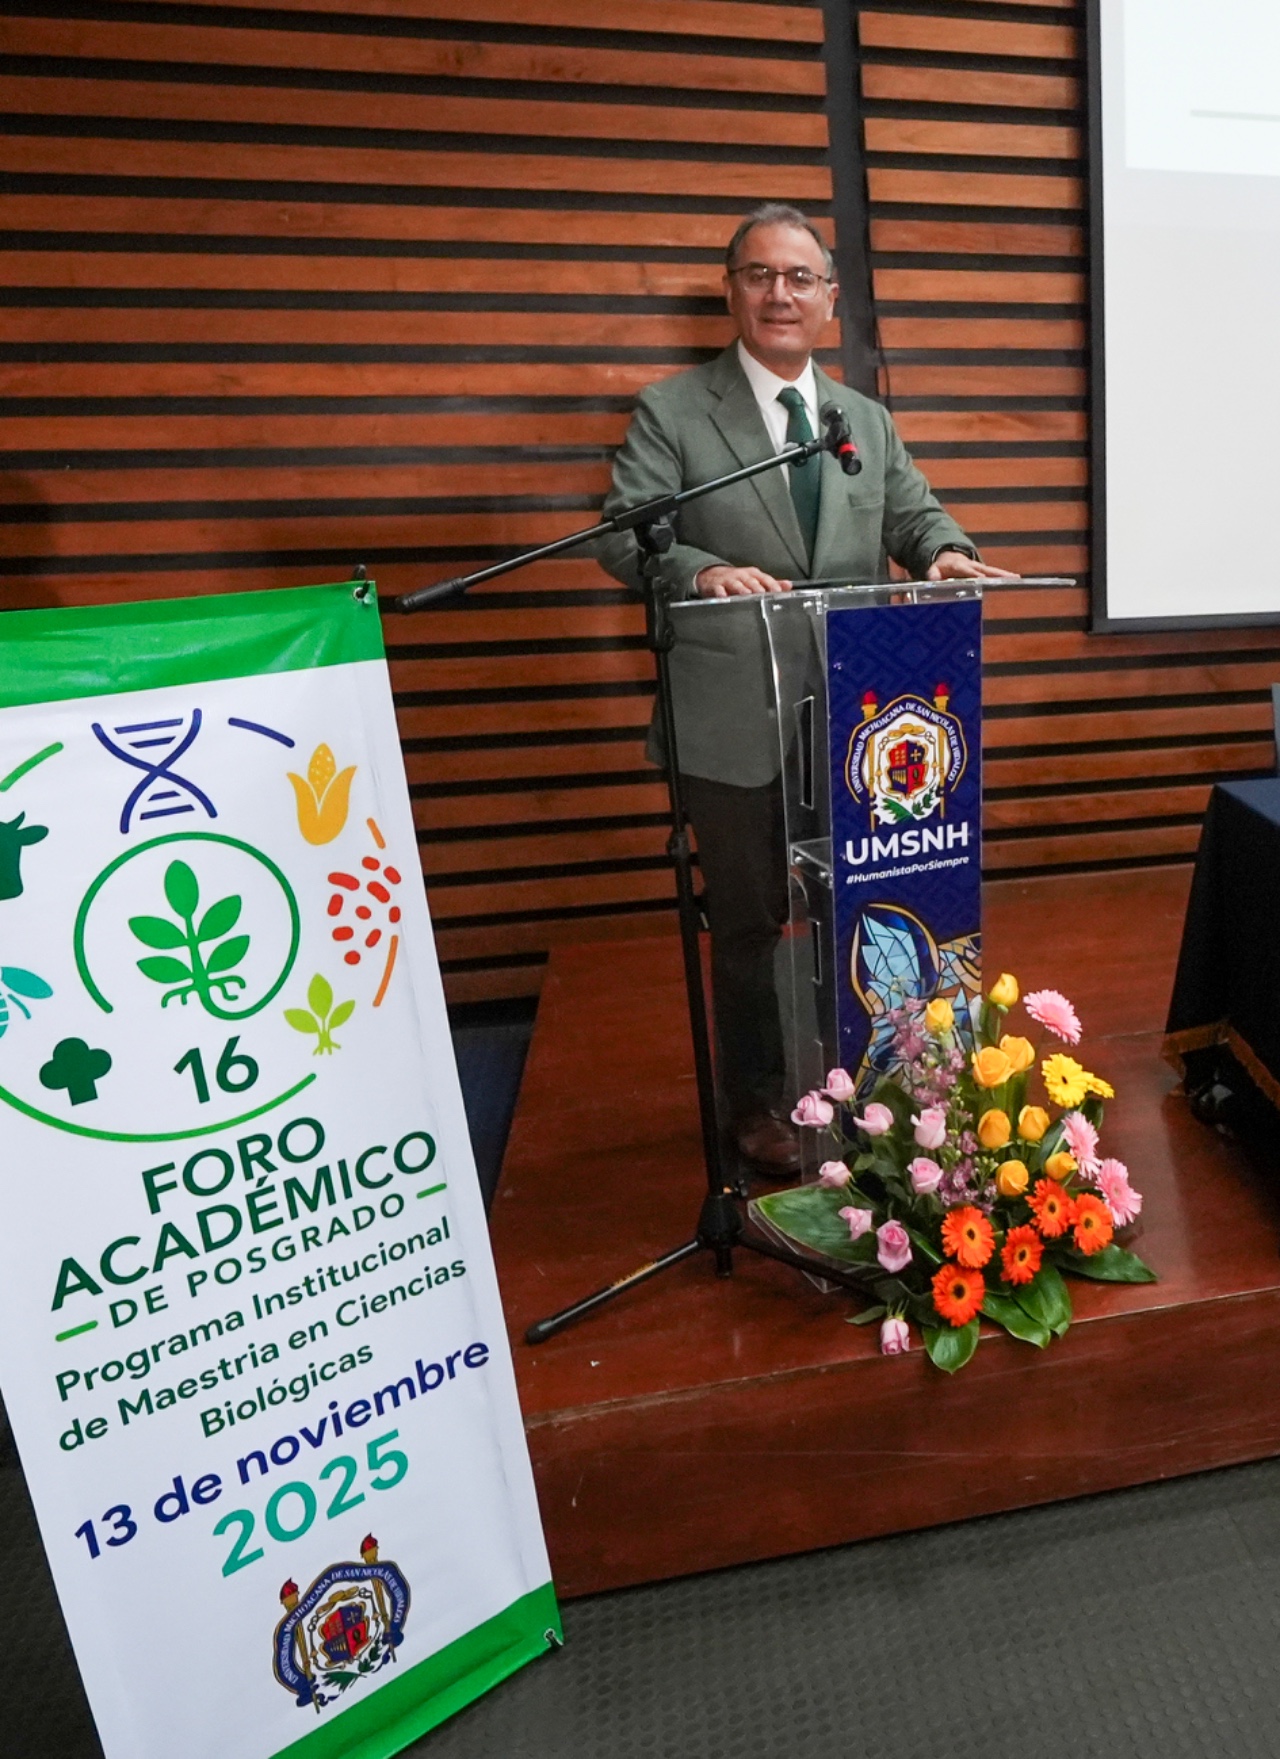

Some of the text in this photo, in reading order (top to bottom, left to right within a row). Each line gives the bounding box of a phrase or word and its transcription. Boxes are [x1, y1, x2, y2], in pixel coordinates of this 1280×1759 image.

[859, 705, 905, 741] MICHOACANA
[906, 702, 916, 713] DE
[916, 705, 931, 720] SAN
[846, 821, 969, 865] UMSNH
[846, 856, 969, 884] #HumanistaPorSiempre
[174, 1036, 259, 1103] 16
[142, 1117, 325, 1214] FORO
[51, 1131, 437, 1311] ACADÉMICO
[109, 1193, 405, 1328] DE POSGRADO
[56, 1216, 451, 1402] Programa Institucional
[59, 1259, 467, 1452] de Maestria en Ciencias
[200, 1345, 374, 1438] Biológicas
[75, 1342, 489, 1559] 13 de noviembre
[213, 1430, 409, 1577] 2025
[284, 1578, 331, 1633] MICHOACANA
[331, 1570, 344, 1581] DE
[344, 1568, 360, 1578] SAN
